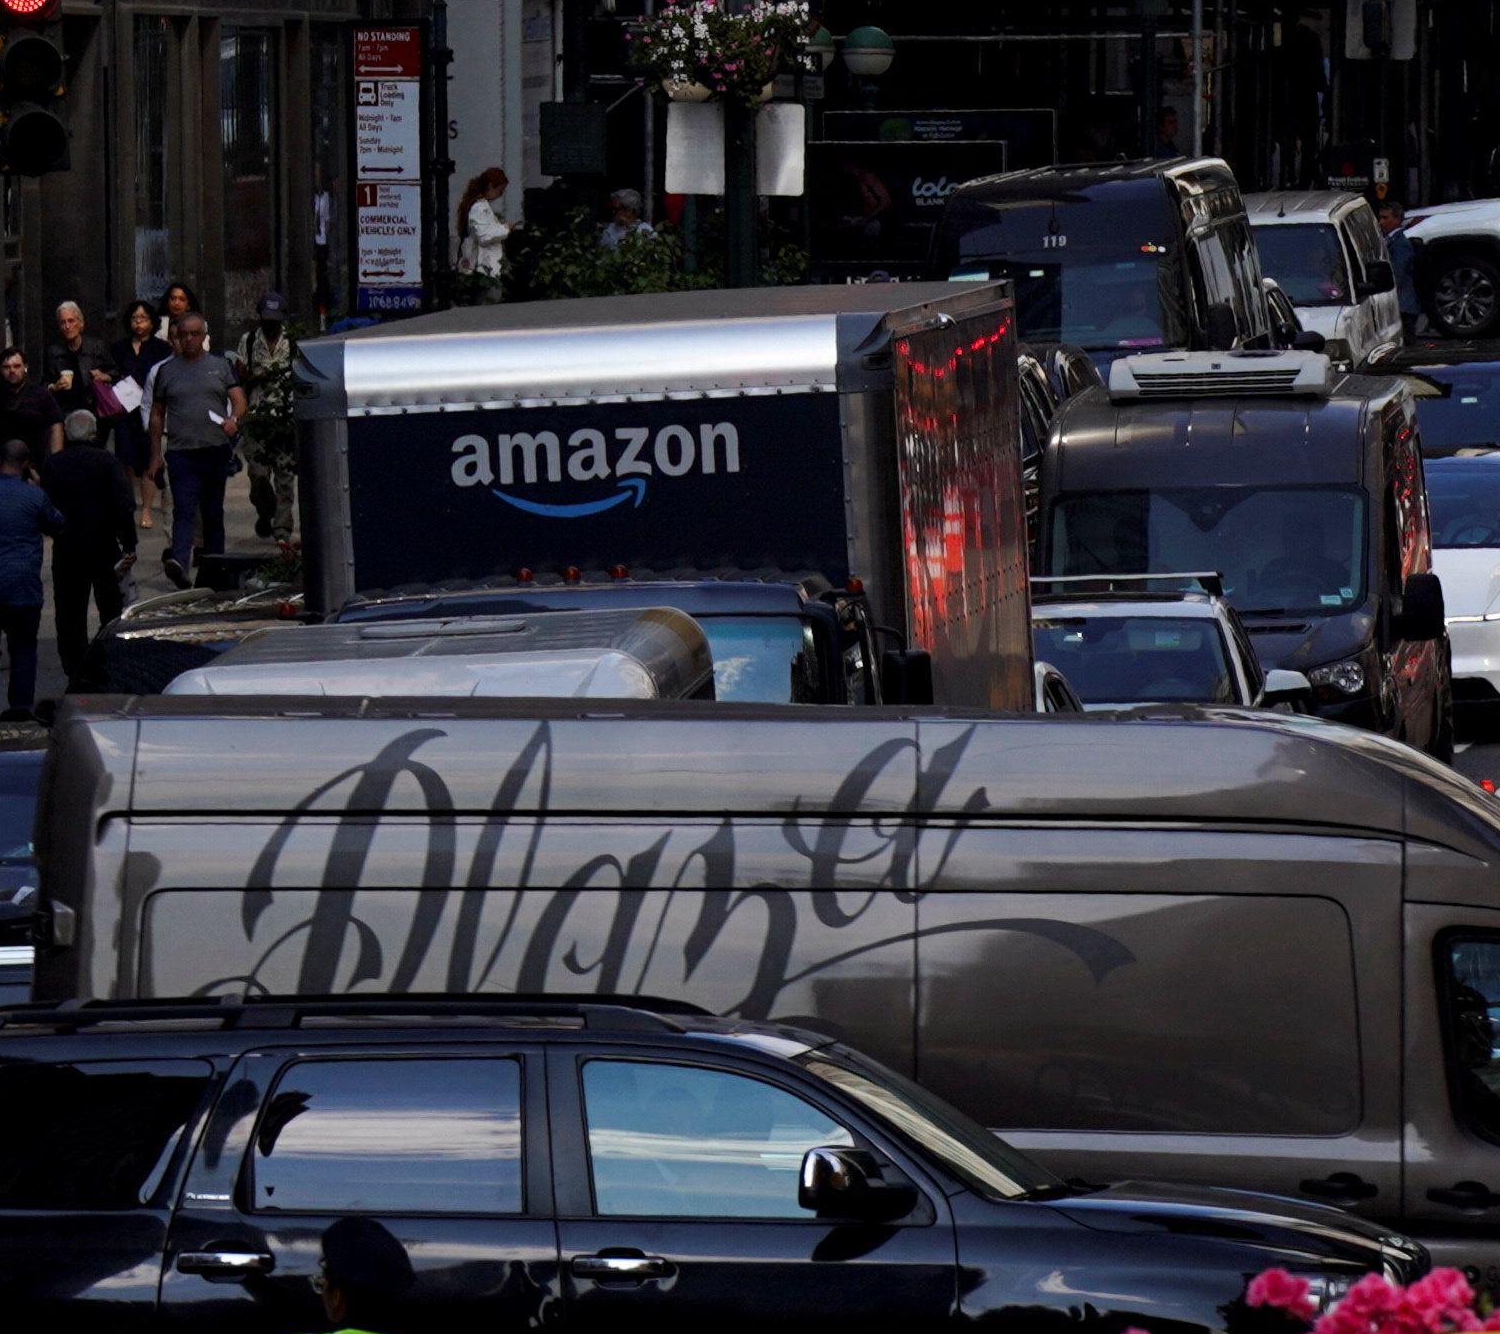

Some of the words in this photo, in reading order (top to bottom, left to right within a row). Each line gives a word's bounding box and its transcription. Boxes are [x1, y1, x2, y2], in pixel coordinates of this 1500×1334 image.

[358, 31, 370, 42] NO
[371, 32, 411, 43] STANDING
[380, 83, 398, 91] Truck
[380, 92, 405, 101] Loading
[359, 114, 385, 123] Midnight
[368, 123, 383, 132] Days
[359, 136, 381, 146] Sunday
[377, 145, 404, 155] Midnight
[359, 215, 408, 225] COMMERCIAL
[360, 226, 395, 236] VEHICLES
[397, 225, 417, 236] ONLY
[1042, 234, 1068, 248] 119
[450, 421, 741, 488] amazon
[192, 720, 1138, 1017] Plaza
